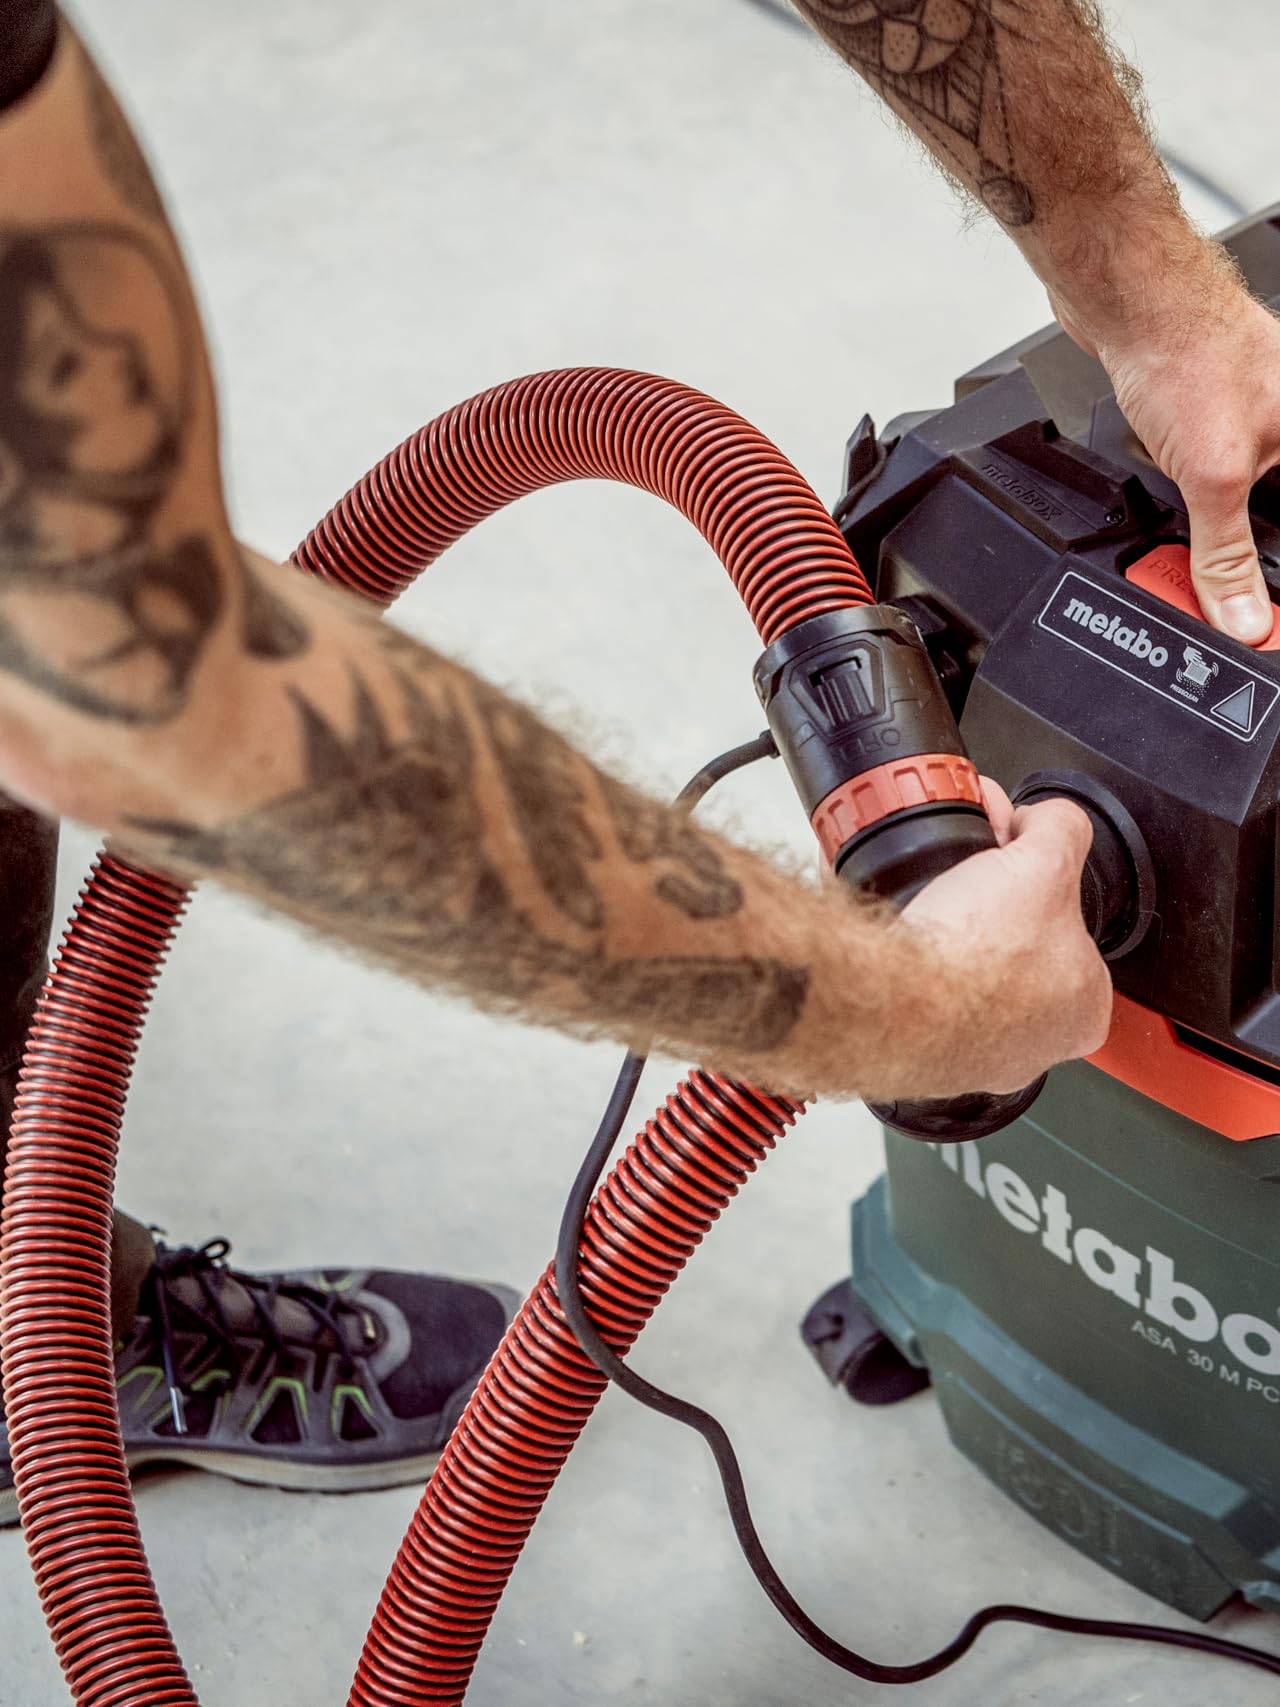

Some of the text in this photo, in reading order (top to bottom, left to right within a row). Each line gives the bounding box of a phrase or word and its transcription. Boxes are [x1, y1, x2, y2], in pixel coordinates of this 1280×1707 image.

[1063, 598, 1169, 668] metabo
[1131, 1319, 1280, 1403] ASA 30 M PC
